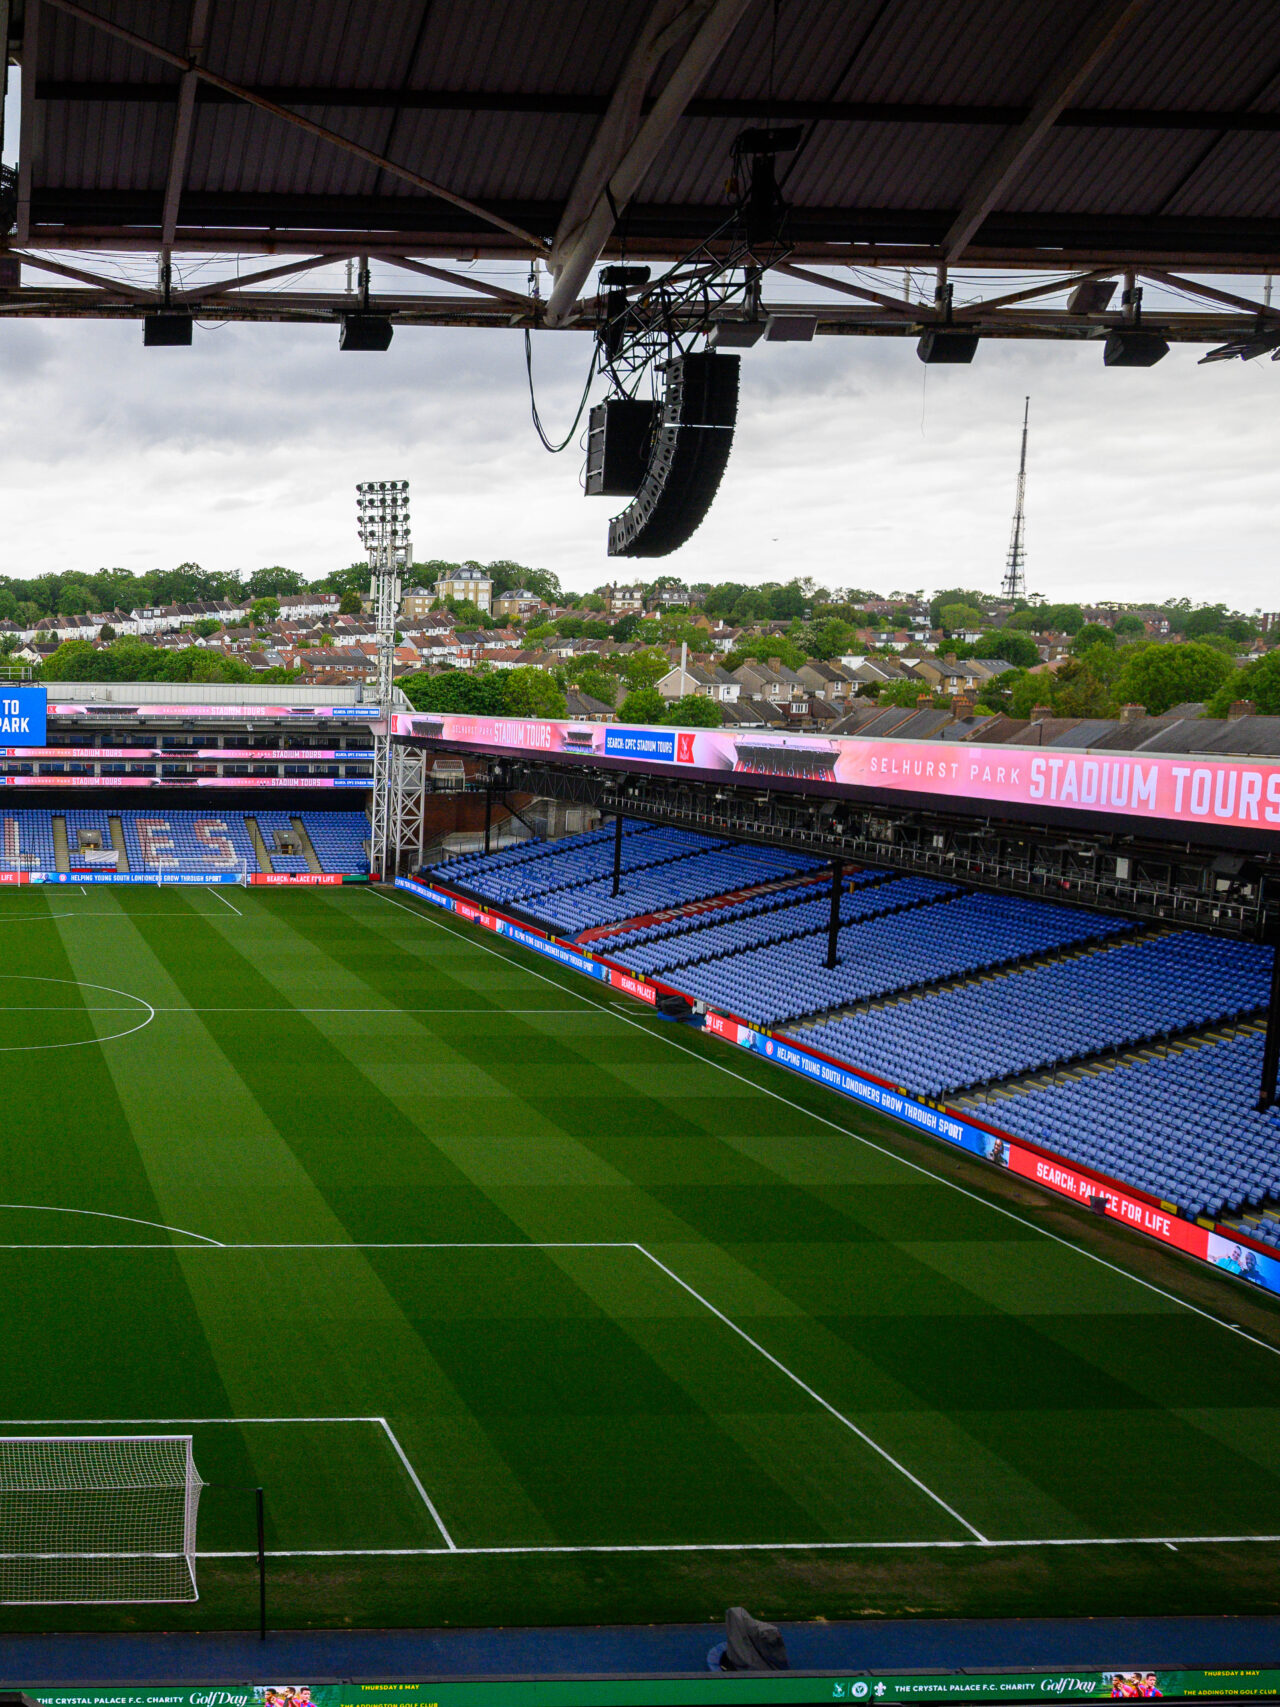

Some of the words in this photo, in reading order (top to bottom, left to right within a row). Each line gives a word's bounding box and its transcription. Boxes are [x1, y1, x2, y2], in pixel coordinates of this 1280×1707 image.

[3, 699, 20, 715] TO
[494, 722, 525, 746] STADIUM
[526, 725, 551, 748] TOURS
[102, 748, 122, 757] TOURS
[607, 737, 625, 749] SEARCH:
[625, 738, 637, 751] CPFC
[637, 740, 657, 752] STADIUM
[657, 741, 673, 754] TOURS
[301, 750, 321, 758] TOURS
[101, 777, 122, 785] TOURS
[301, 778, 321, 787] TOURS
[870, 756, 959, 779] SELHURST
[970, 764, 1021, 785] PARK
[1029, 758, 1158, 810] STADIUM
[1171, 767, 1280, 823] TOURS
[2, 873, 13, 881] LIFE
[71, 874, 93, 882] HELPING
[94, 874, 112, 882] YOUNG
[323, 875, 334, 883] LIFE
[652, 899, 724, 921] SOUTH
[637, 984, 651, 1000] PALACE
[713, 1017, 724, 1033] LIFE
[776, 1046, 800, 1067] HELPING
[801, 1056, 821, 1077] YOUNG
[821, 1066, 841, 1086] SOUTH
[841, 1075, 880, 1104] LONDONERS
[881, 1093, 903, 1112] GROW
[904, 1103, 937, 1128] THROUGH
[938, 1118, 964, 1141] SPORT
[1036, 1162, 1077, 1193] SEARCH:
[1121, 1200, 1141, 1223] FOR
[1145, 1211, 1171, 1236] LIFE
[912, 1684, 948, 1692] CRYSTAL
[983, 1683, 998, 1691] F.C.
[1000, 1683, 1035, 1691] CHARITY
[1068, 1678, 1096, 1693] Day
[36, 1697, 53, 1705] THE
[55, 1697, 92, 1705] CRYSTAL
[128, 1696, 144, 1704] F.C.
